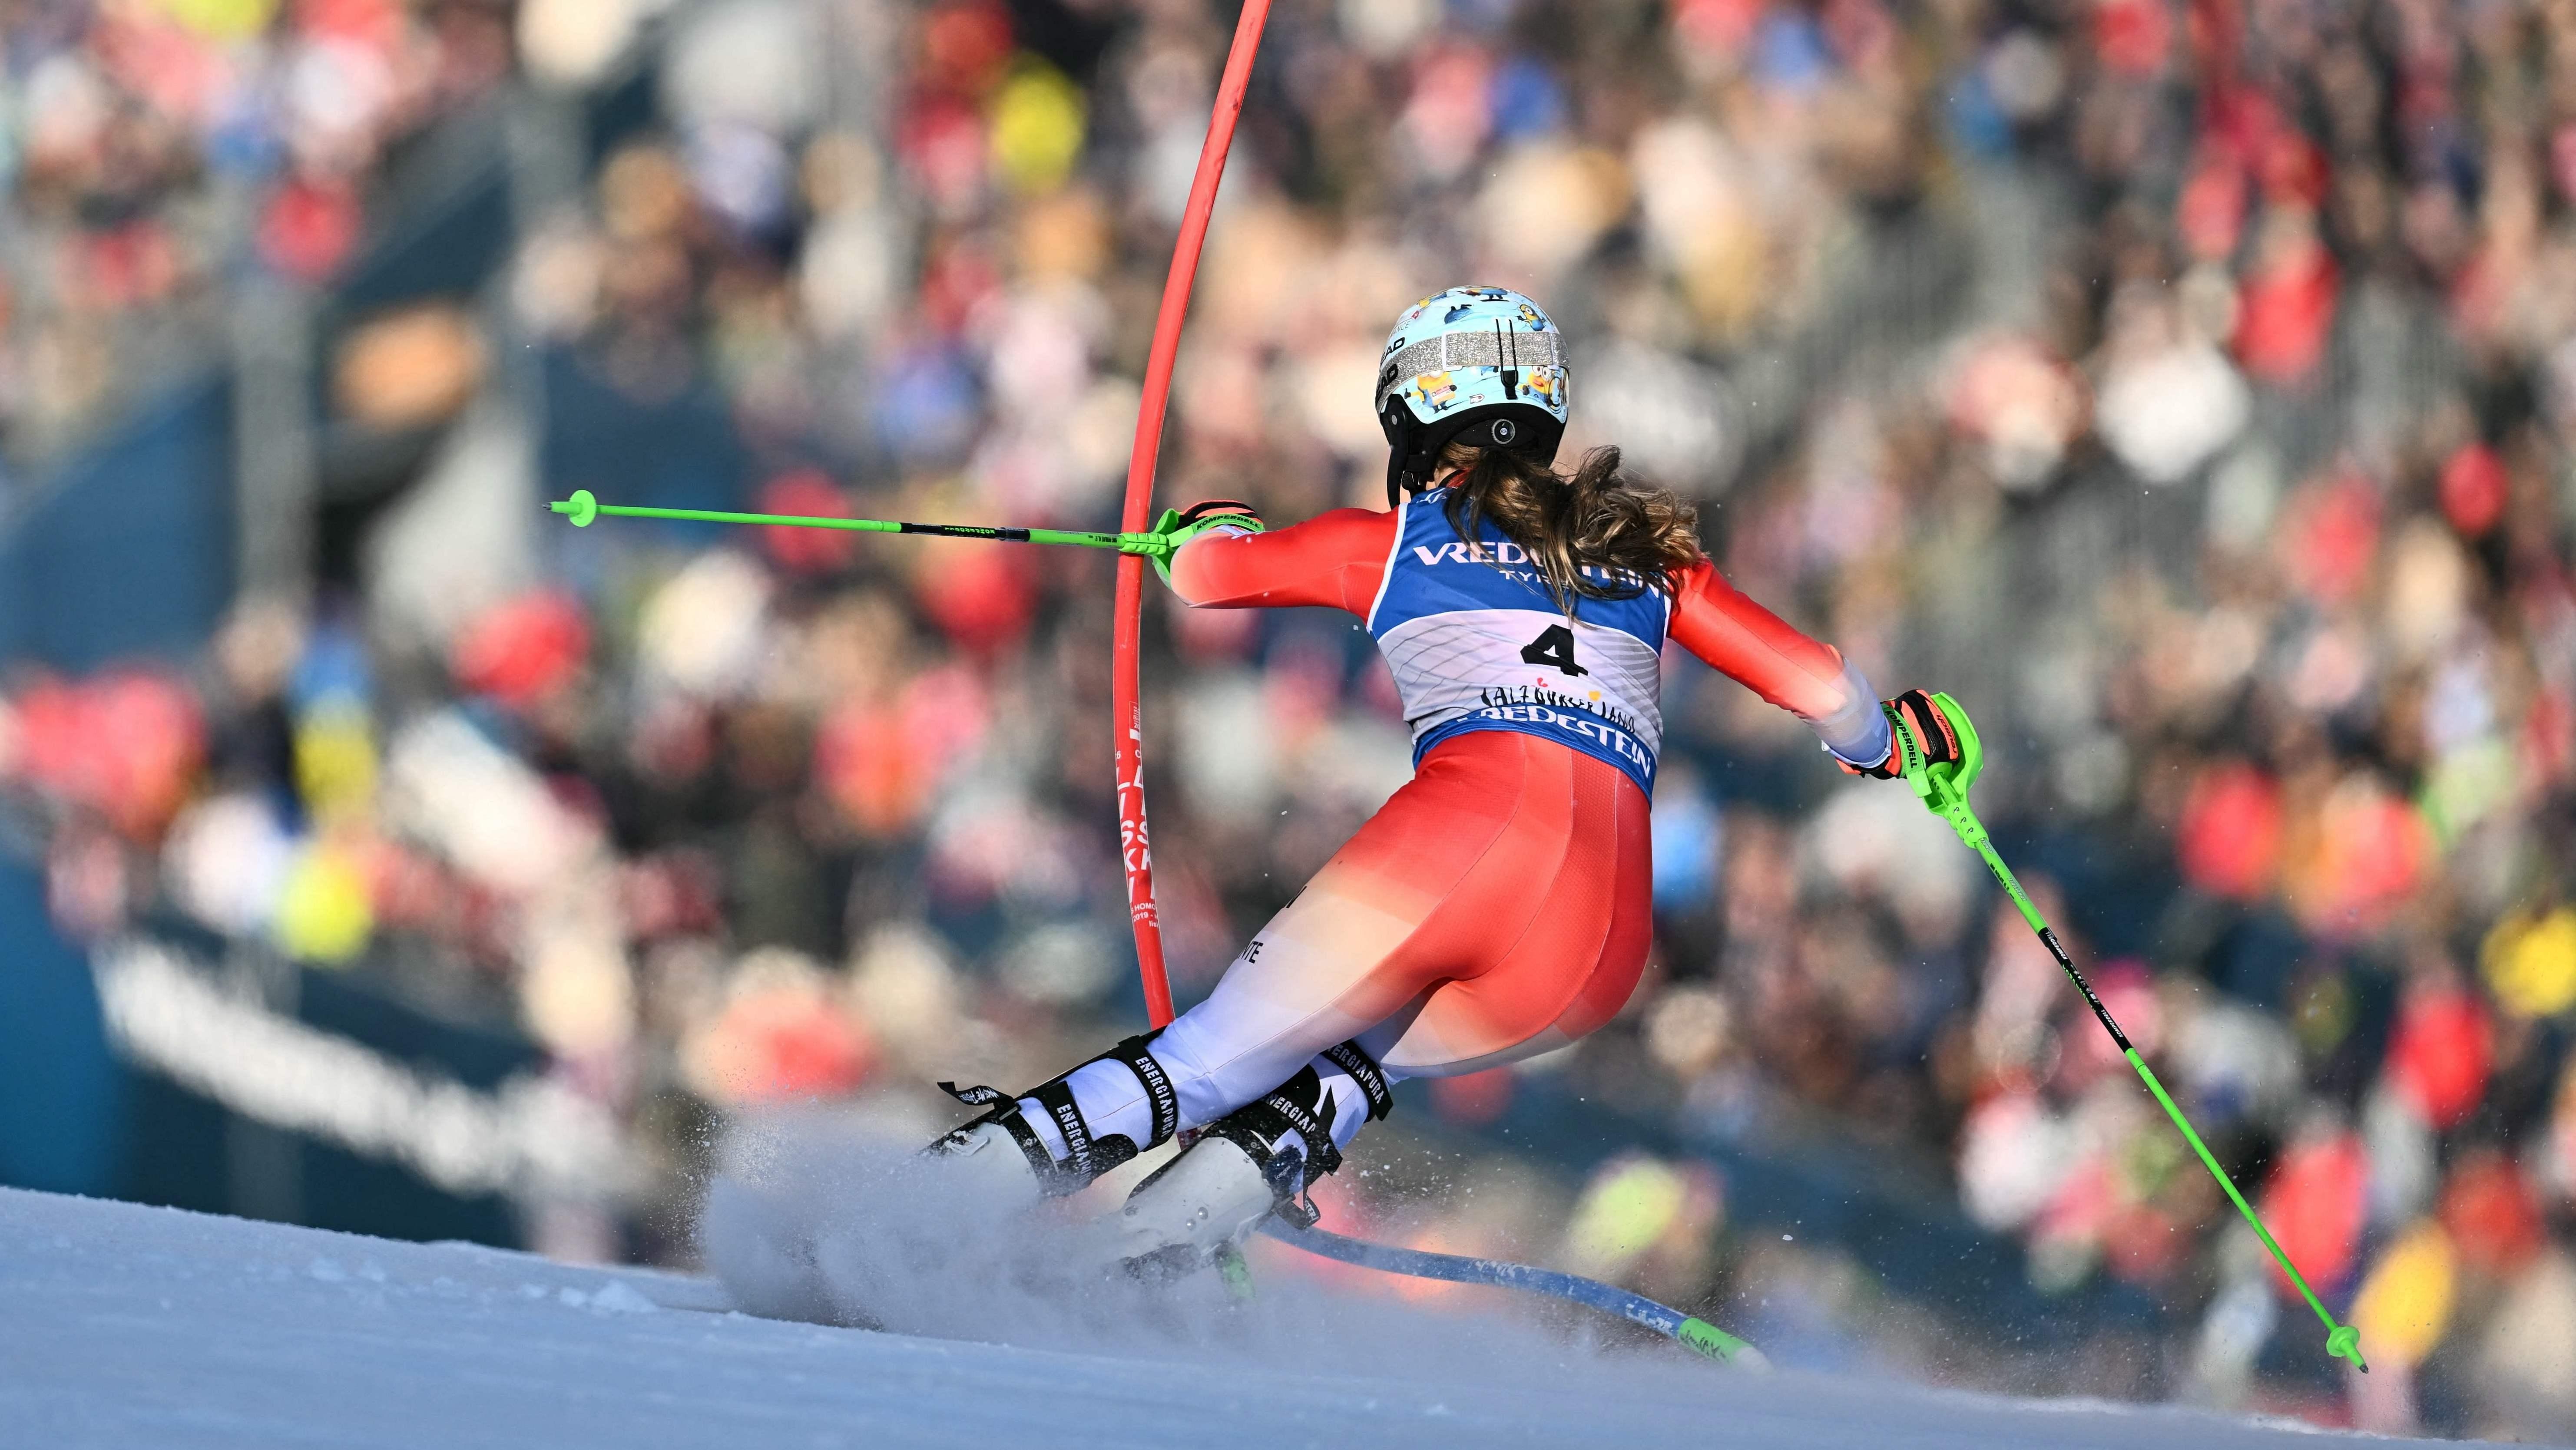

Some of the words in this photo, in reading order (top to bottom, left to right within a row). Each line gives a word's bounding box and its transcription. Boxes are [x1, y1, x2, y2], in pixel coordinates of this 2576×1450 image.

[1380, 337, 1405, 366] EAD
[944, 522, 995, 534] KOMPERDELL
[1196, 515, 1259, 531] KOMPERDELL
[1520, 624, 1589, 677] 4
[1456, 705, 1651, 779] REDESTEIN
[1885, 710, 1918, 769] KOMPERDELL
[1936, 714, 1957, 754] reusch
[2045, 931, 2068, 960] KOMPERDELL
[2100, 1009, 2124, 1037] KOMPERDELL
[1328, 1044, 1384, 1104] ERGIAPURA
[1135, 1056, 1175, 1139] ENERGIAPURA
[1265, 1094, 1316, 1133] NERGIAP
